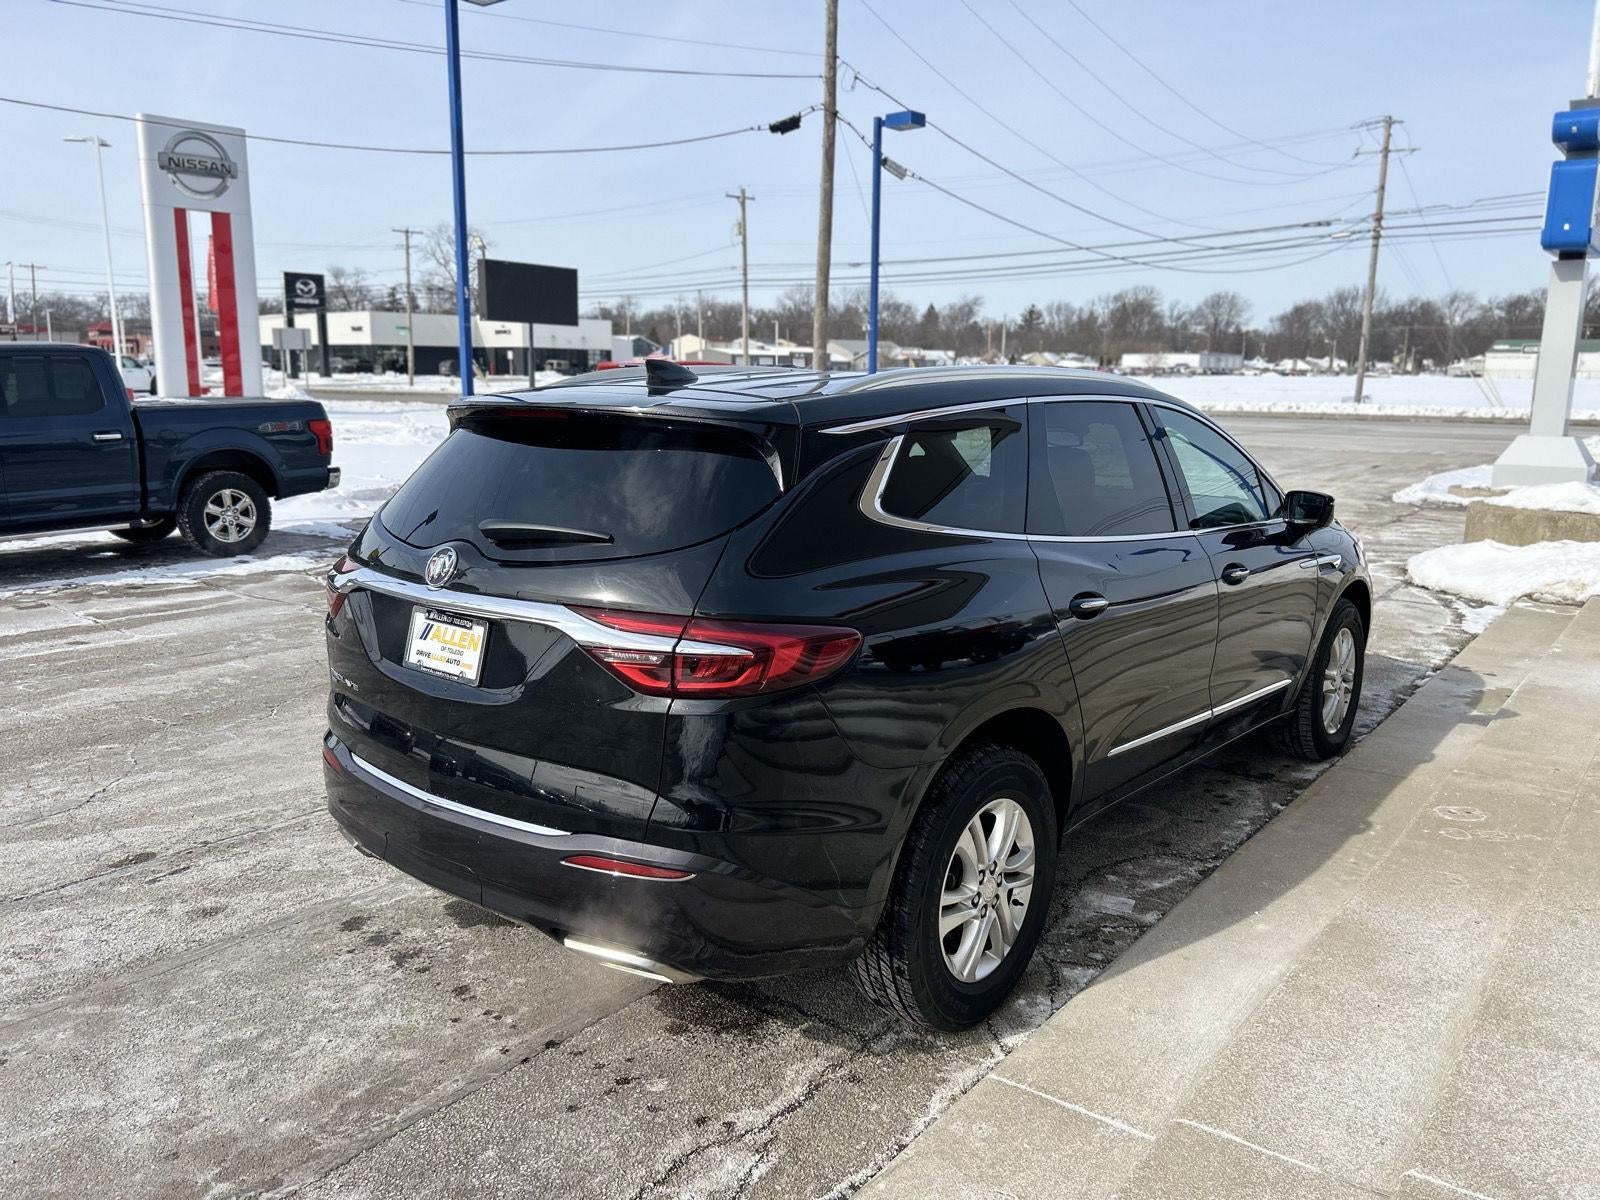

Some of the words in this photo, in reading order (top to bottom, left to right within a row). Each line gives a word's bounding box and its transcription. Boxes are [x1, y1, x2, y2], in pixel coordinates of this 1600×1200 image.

[167, 156, 232, 174] NISSAN
[431, 625, 480, 651] ALLEN
[448, 647, 464, 656] TOLEDO
